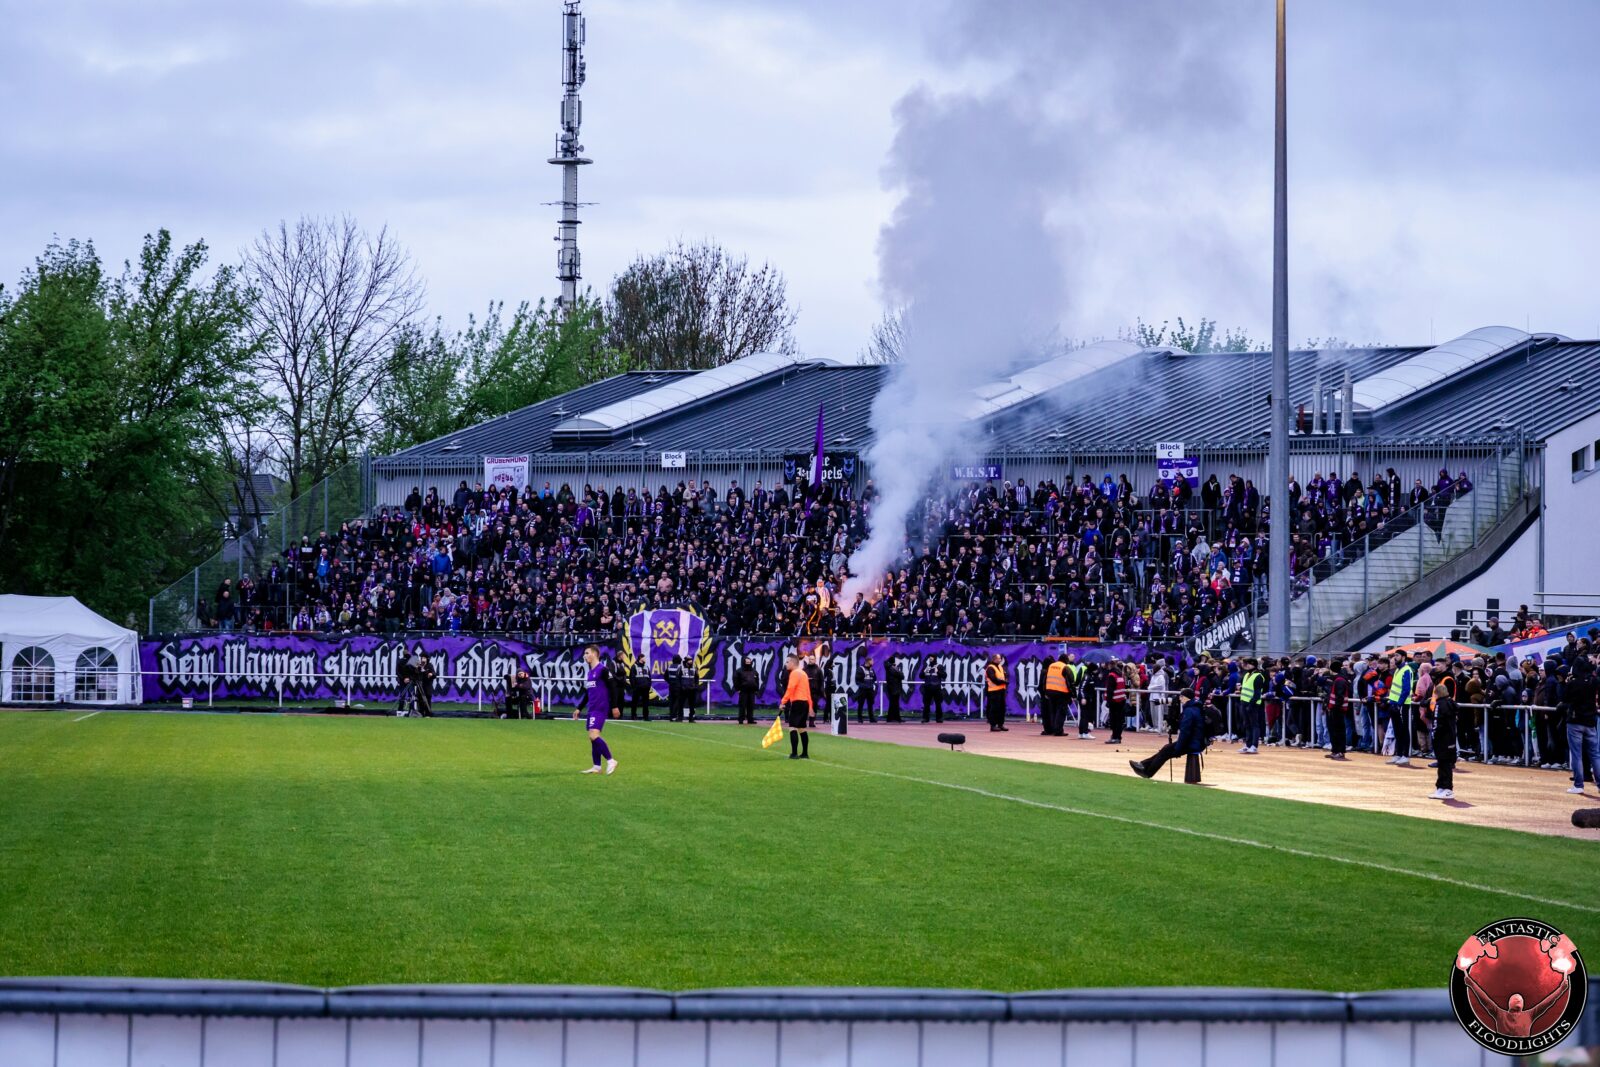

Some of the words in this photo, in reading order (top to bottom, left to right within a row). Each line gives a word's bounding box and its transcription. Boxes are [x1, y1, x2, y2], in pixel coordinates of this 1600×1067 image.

[954, 466, 999, 478] W.K.S.T.
[1195, 611, 1246, 655] OLBERNHAU
[727, 639, 774, 691] dr
